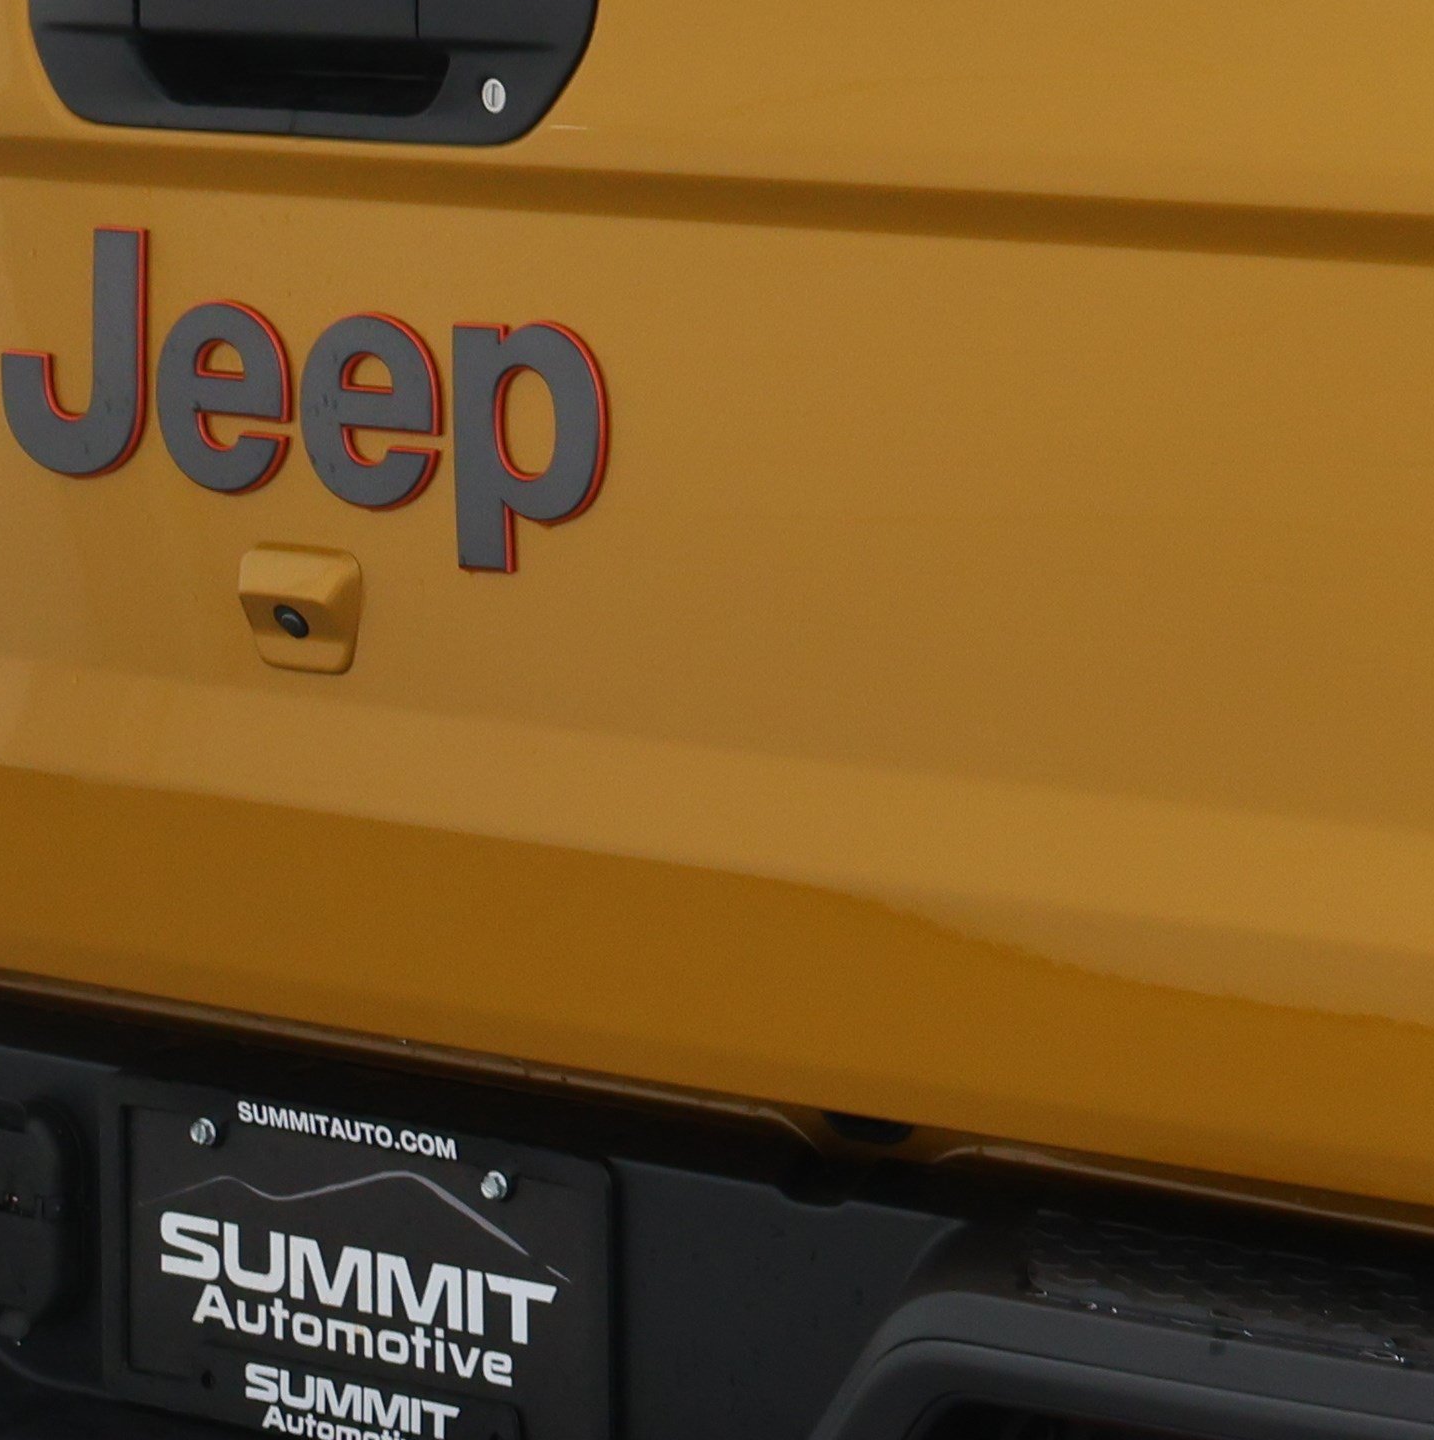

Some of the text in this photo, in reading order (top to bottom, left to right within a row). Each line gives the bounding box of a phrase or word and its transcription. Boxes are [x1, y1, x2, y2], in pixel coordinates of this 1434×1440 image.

[0, 224, 608, 574] Jeep
[237, 1100, 456, 1161] SUMMITAUTO.COM
[160, 1211, 557, 1345] SUMMIT
[192, 1284, 513, 1387] Automotive
[245, 1362, 460, 1440] SUMMIT
